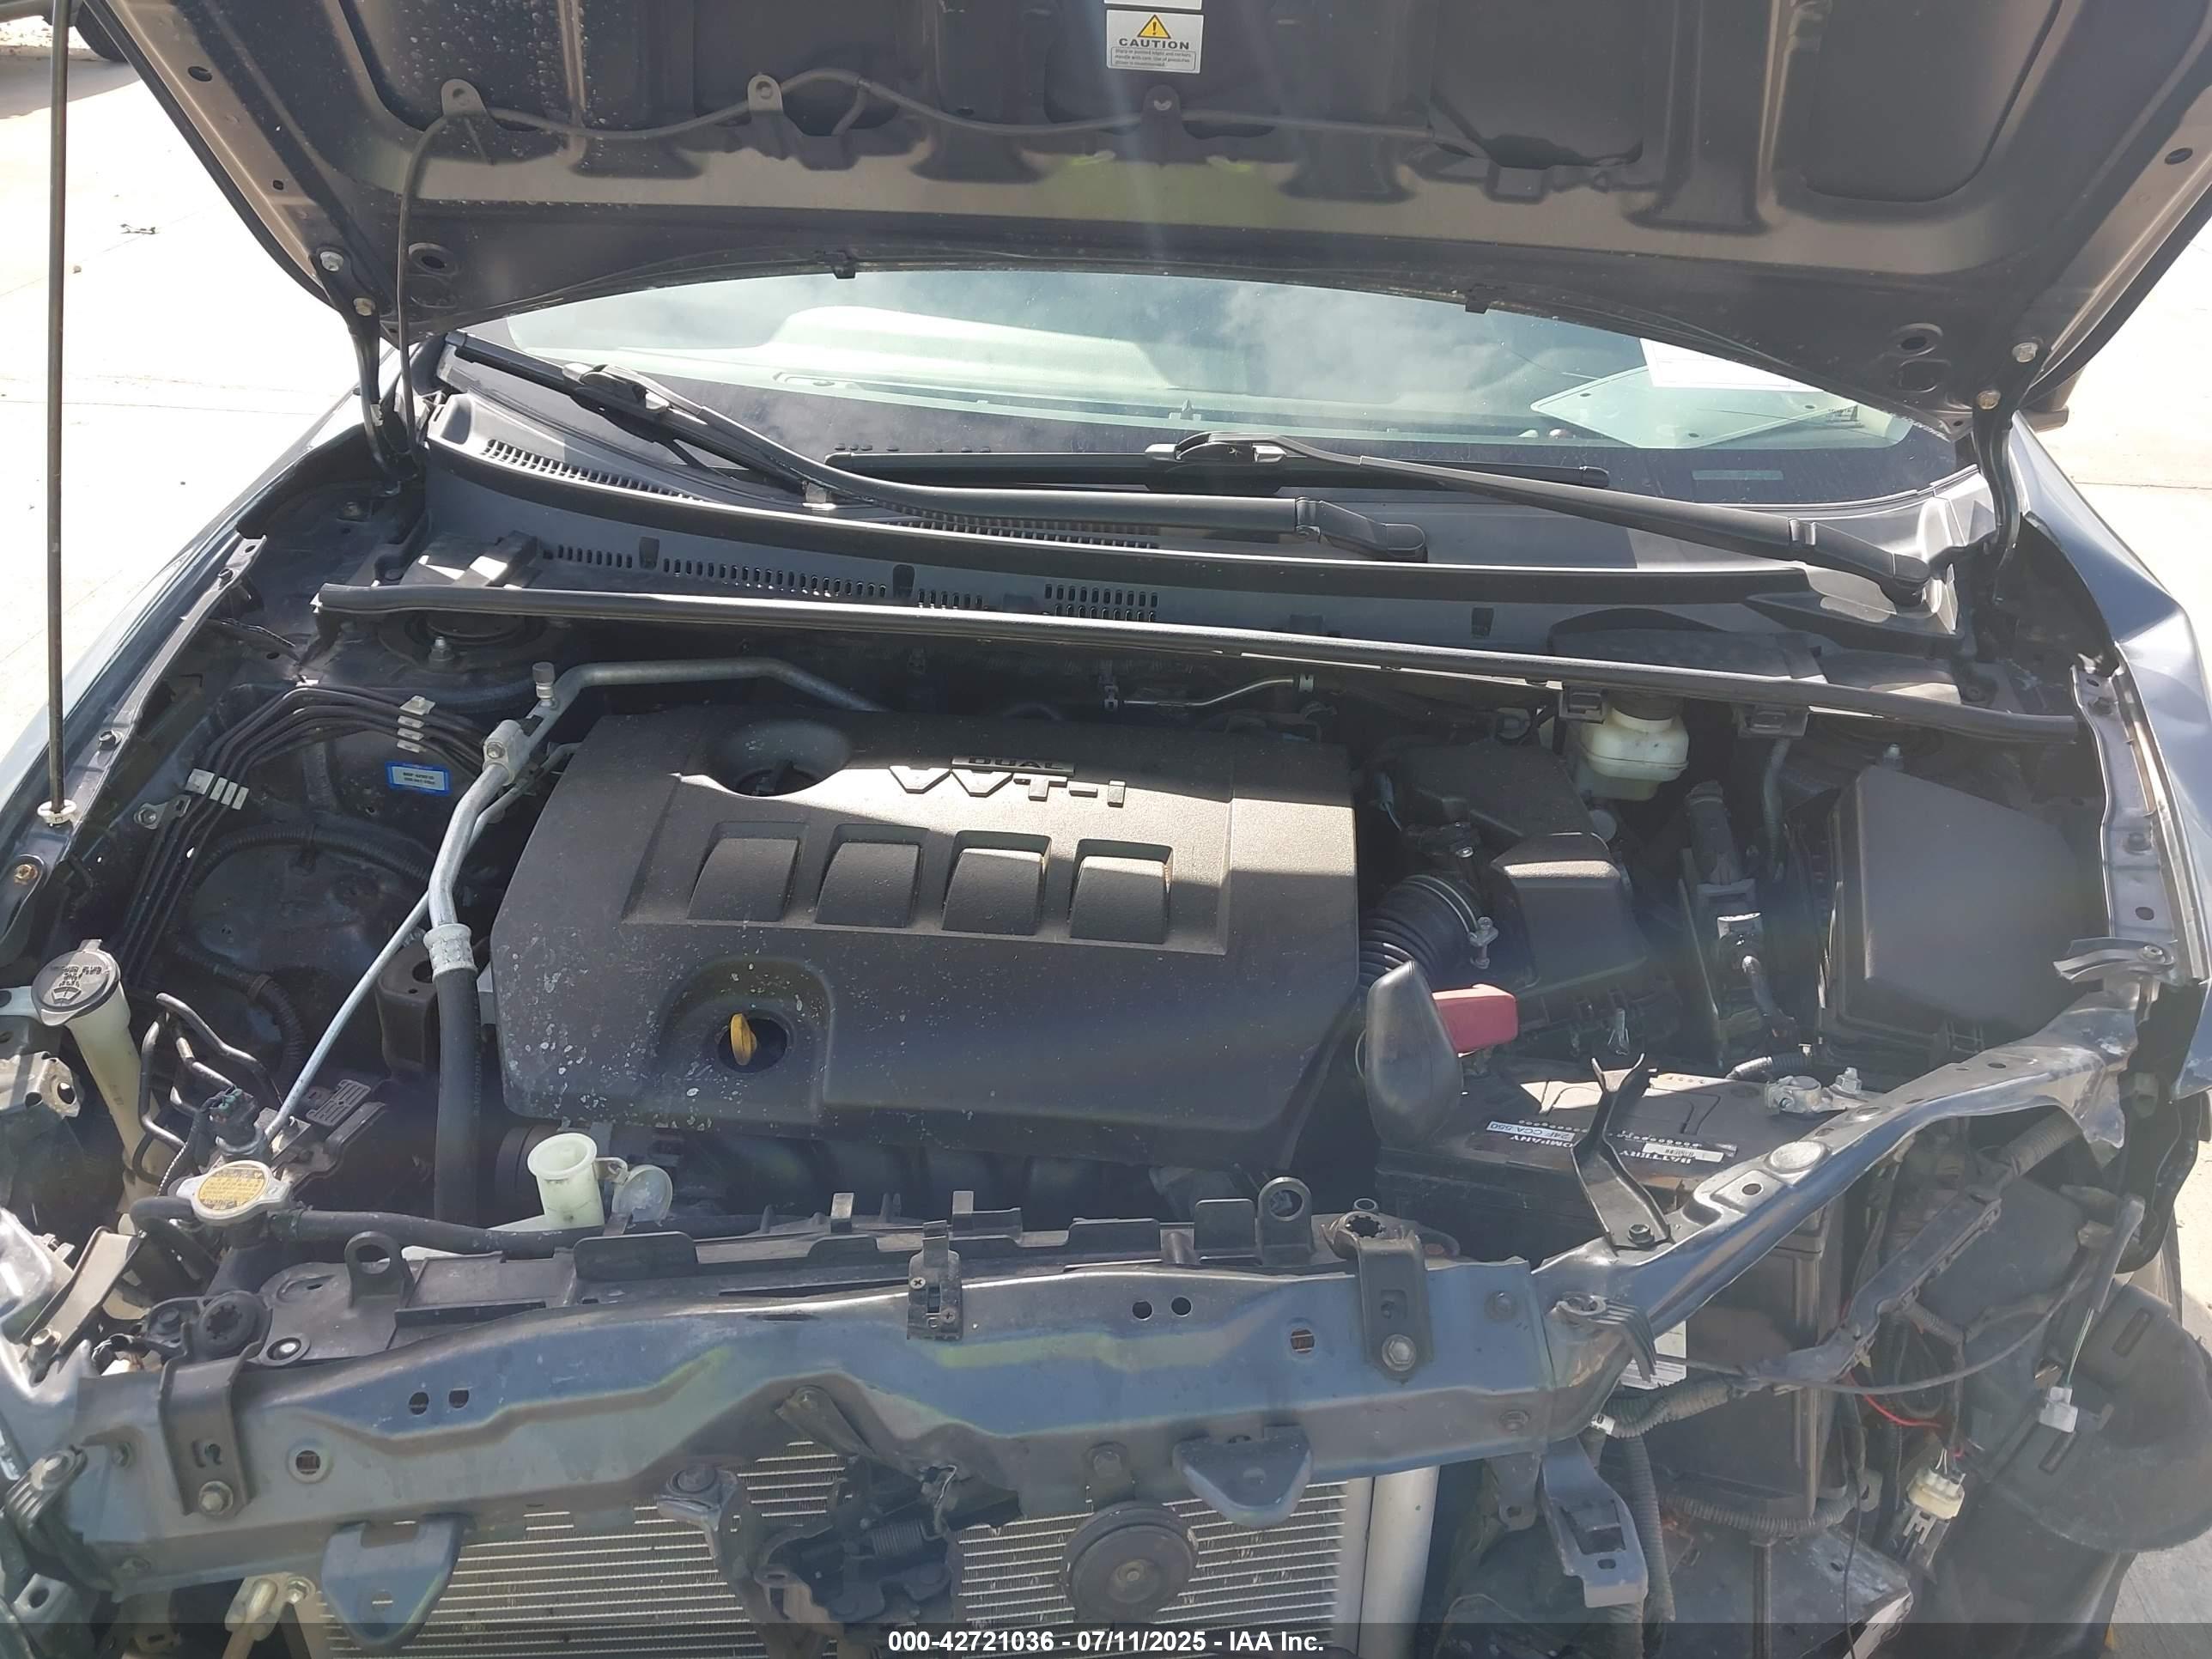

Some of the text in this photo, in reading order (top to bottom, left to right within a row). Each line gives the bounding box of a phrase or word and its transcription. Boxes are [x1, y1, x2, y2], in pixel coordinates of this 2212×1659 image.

[1119, 38, 1189, 50] CAUTION
[969, 757, 1065, 770] DUAL
[1516, 1127, 1543, 1135] CCA
[1509, 1134, 1573, 1148] OMPANY
